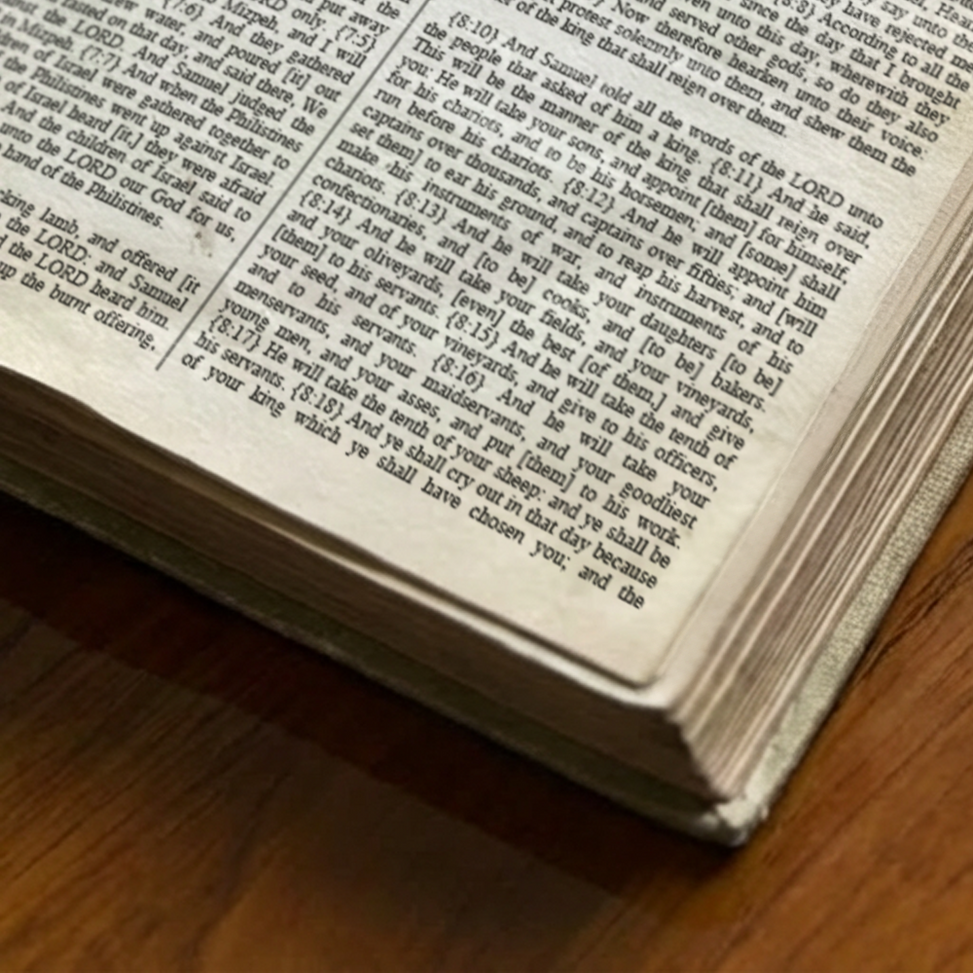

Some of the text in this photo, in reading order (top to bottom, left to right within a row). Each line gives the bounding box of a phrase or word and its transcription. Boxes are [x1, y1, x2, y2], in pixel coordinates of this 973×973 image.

[534, 7, 560, 27] the
[559, 17, 595, 47] king
[596, 36, 629, 59] that
[628, 52, 668, 78] shall
[666, 71, 707, 98] reign
[708, 91, 745, 115] over
[818, 12, 898, 61] According
[901, 51, 919, 68] to
[919, 62, 944, 80] all
[944, 72, 971, 93] the
[3, 143, 43, 171] hand
[40, 164, 64, 180] of
[59, 171, 85, 191] the
[434, 69, 460, 91] He
[463, 84, 494, 107] will
[494, 99, 527, 123] take
[526, 116, 566, 141] your
[609, 156, 643, 179] and
[641, 172, 702, 208] appoint
[756, 226, 783, 249] for
[20, 271, 45, 293] the
[49, 283, 91, 315] burnt
[86, 232, 120, 254] and
[121, 249, 178, 282] offered
[355, 217, 394, 244] And
[394, 234, 417, 256] he
[423, 251, 456, 275] will
[458, 269, 492, 294] take
[493, 289, 535, 316] your
[594, 340, 628, 364] and
[627, 358, 670, 385] your
[181, 353, 204, 370] of
[203, 366, 244, 392] your
[248, 384, 286, 418] king
[294, 411, 342, 445] which
[345, 440, 370, 460] ye
[376, 455, 418, 484] shall
[421, 476, 462, 509] have
[468, 506, 525, 544] chosen
[577, 565, 613, 591] and
[617, 585, 645, 609] the
